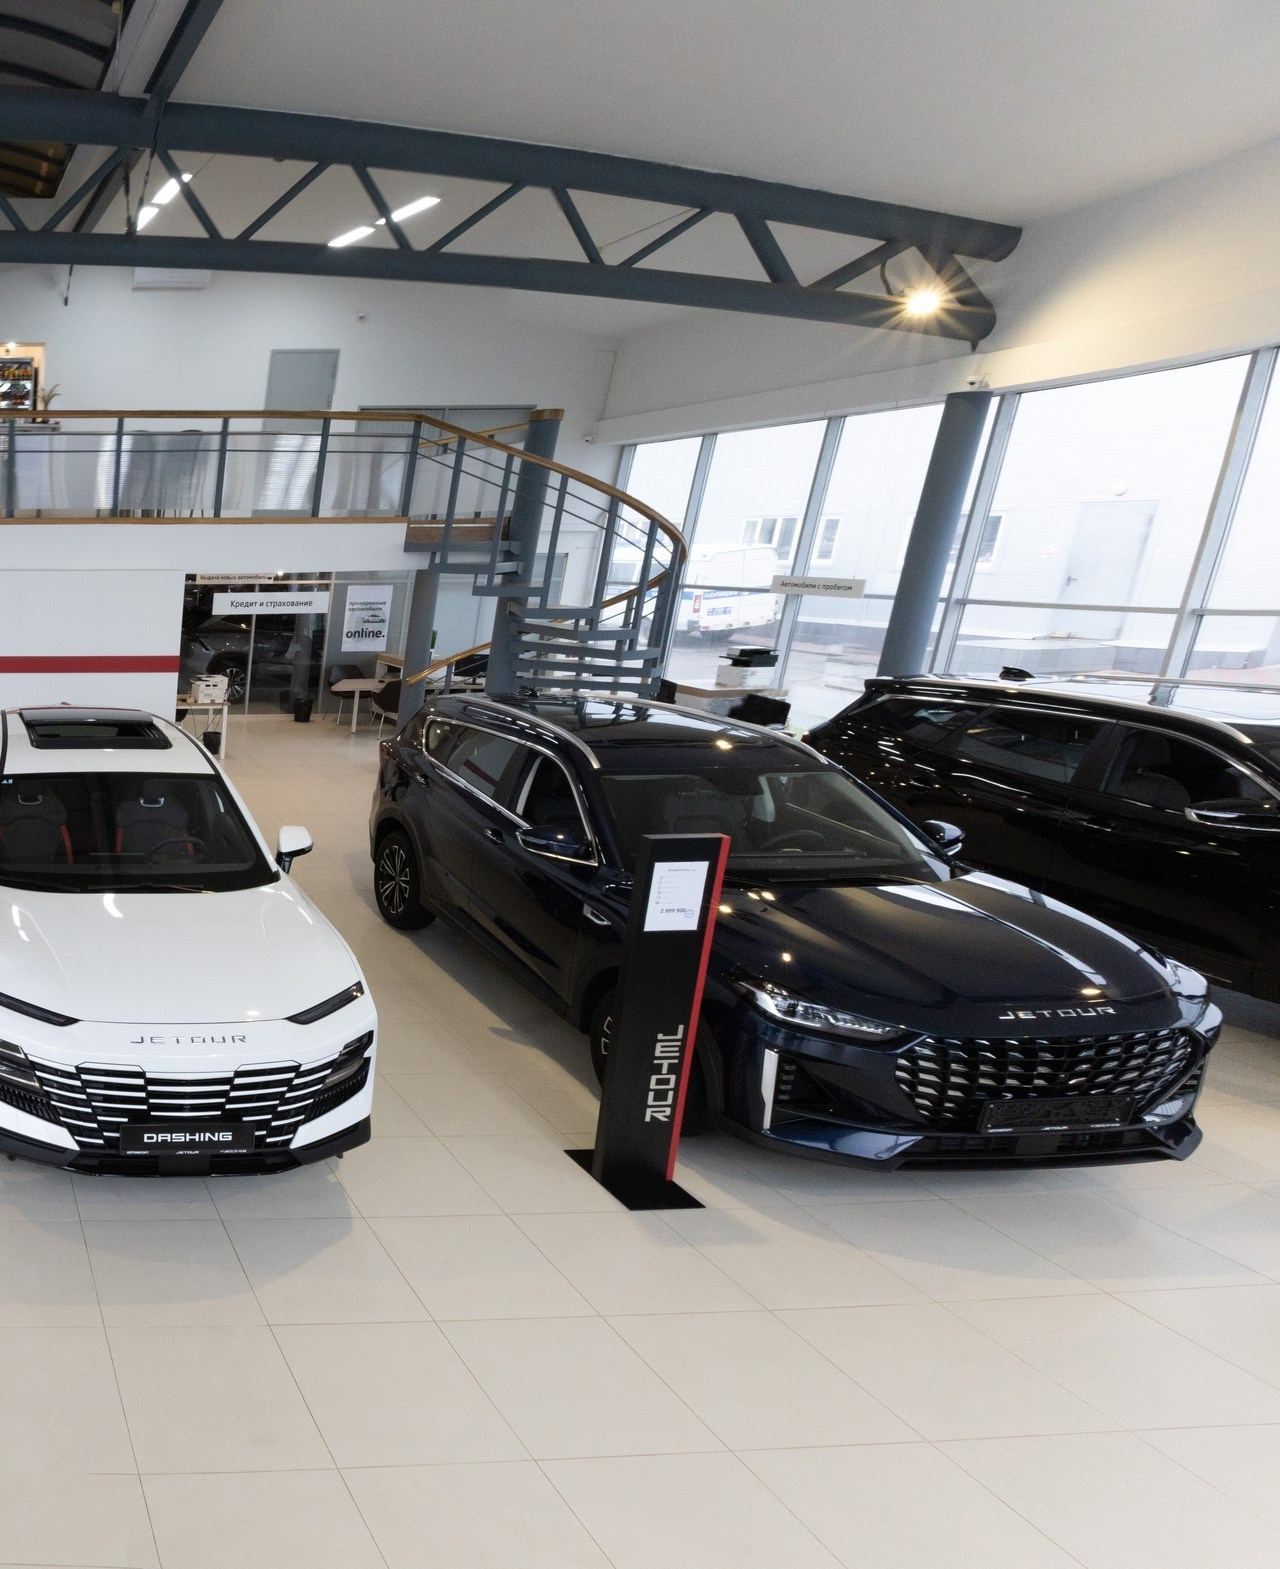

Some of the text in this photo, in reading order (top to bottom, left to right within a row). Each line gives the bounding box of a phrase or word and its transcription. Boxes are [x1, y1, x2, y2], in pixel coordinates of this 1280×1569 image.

[780, 580, 816, 589] Автомобили
[821, 583, 853, 591] пробегом
[230, 599, 257, 609] Кредит
[265, 600, 313, 608] страхование
[345, 627, 385, 639] online.
[998, 1006, 1117, 1020] JETOUR
[130, 1035, 247, 1044] JETOUR
[644, 1024, 684, 1122] JETOUR
[143, 1132, 233, 1142] DASHING
